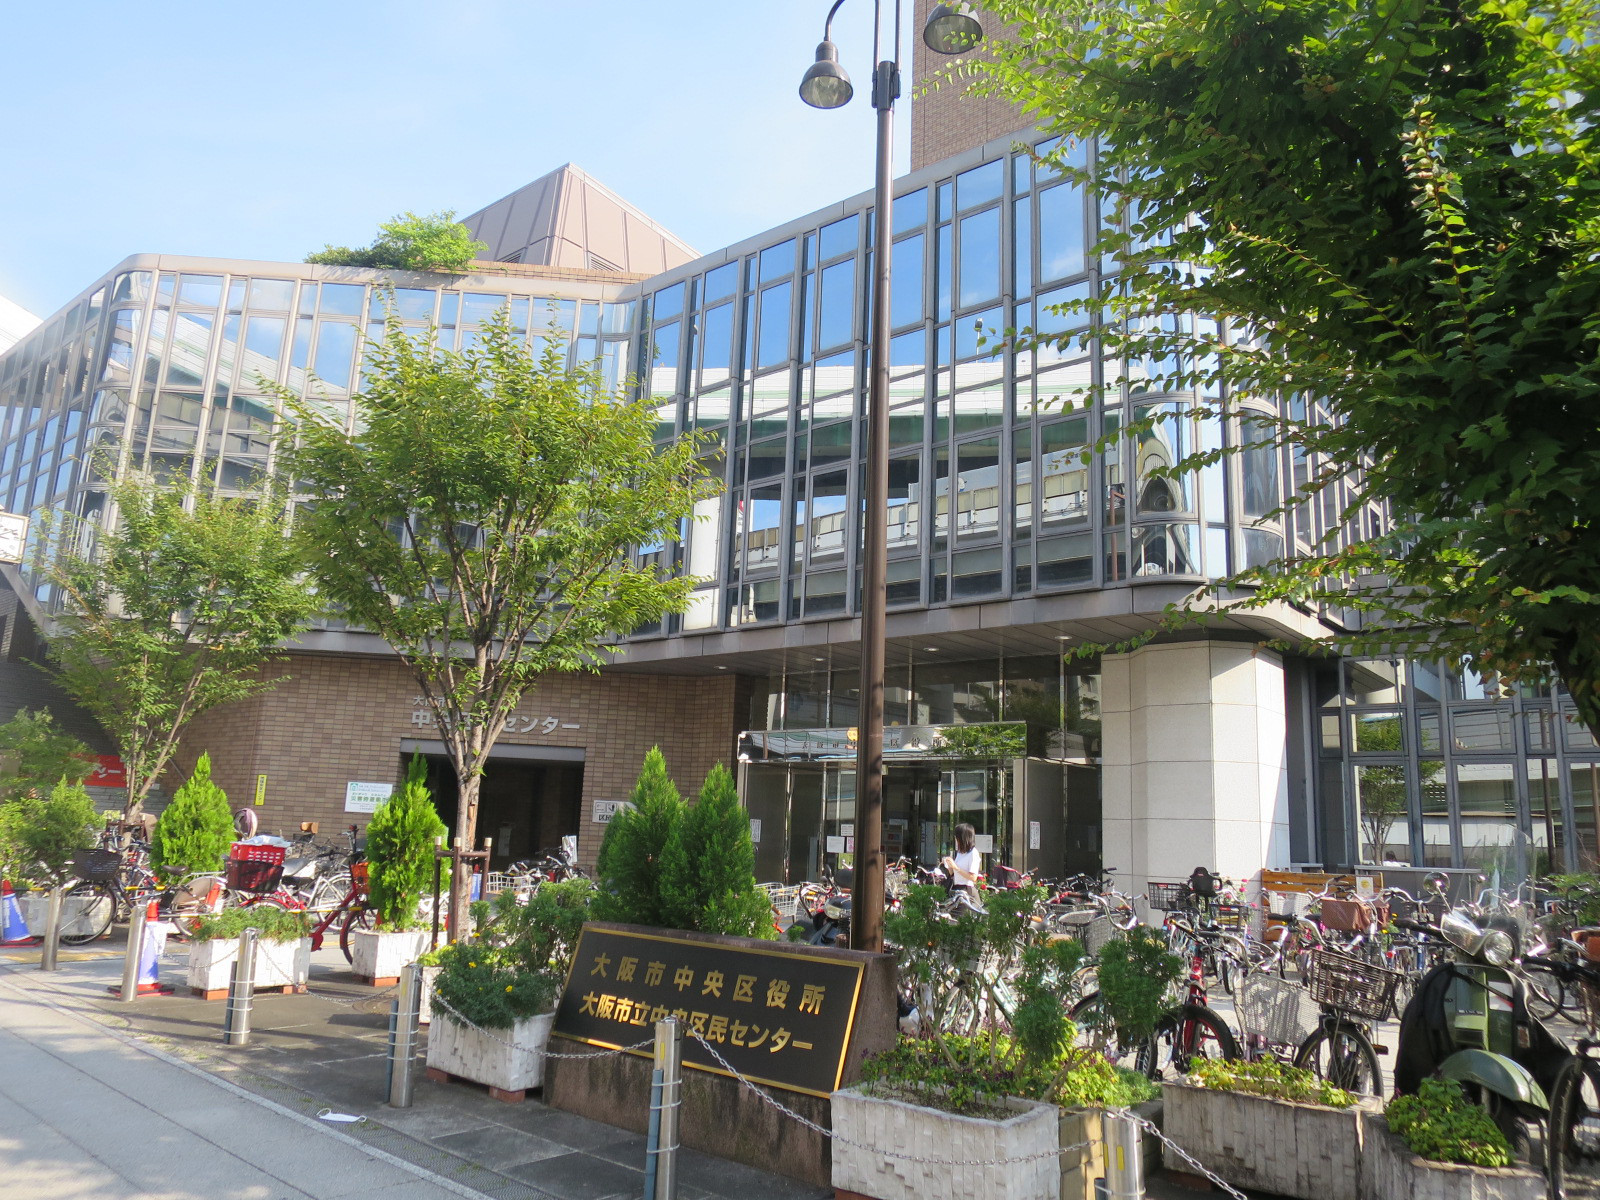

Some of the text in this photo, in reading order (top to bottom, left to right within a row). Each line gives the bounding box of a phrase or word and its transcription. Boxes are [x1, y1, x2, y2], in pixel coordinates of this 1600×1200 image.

[590, 952, 826, 1015] 大阪市中央区役所
